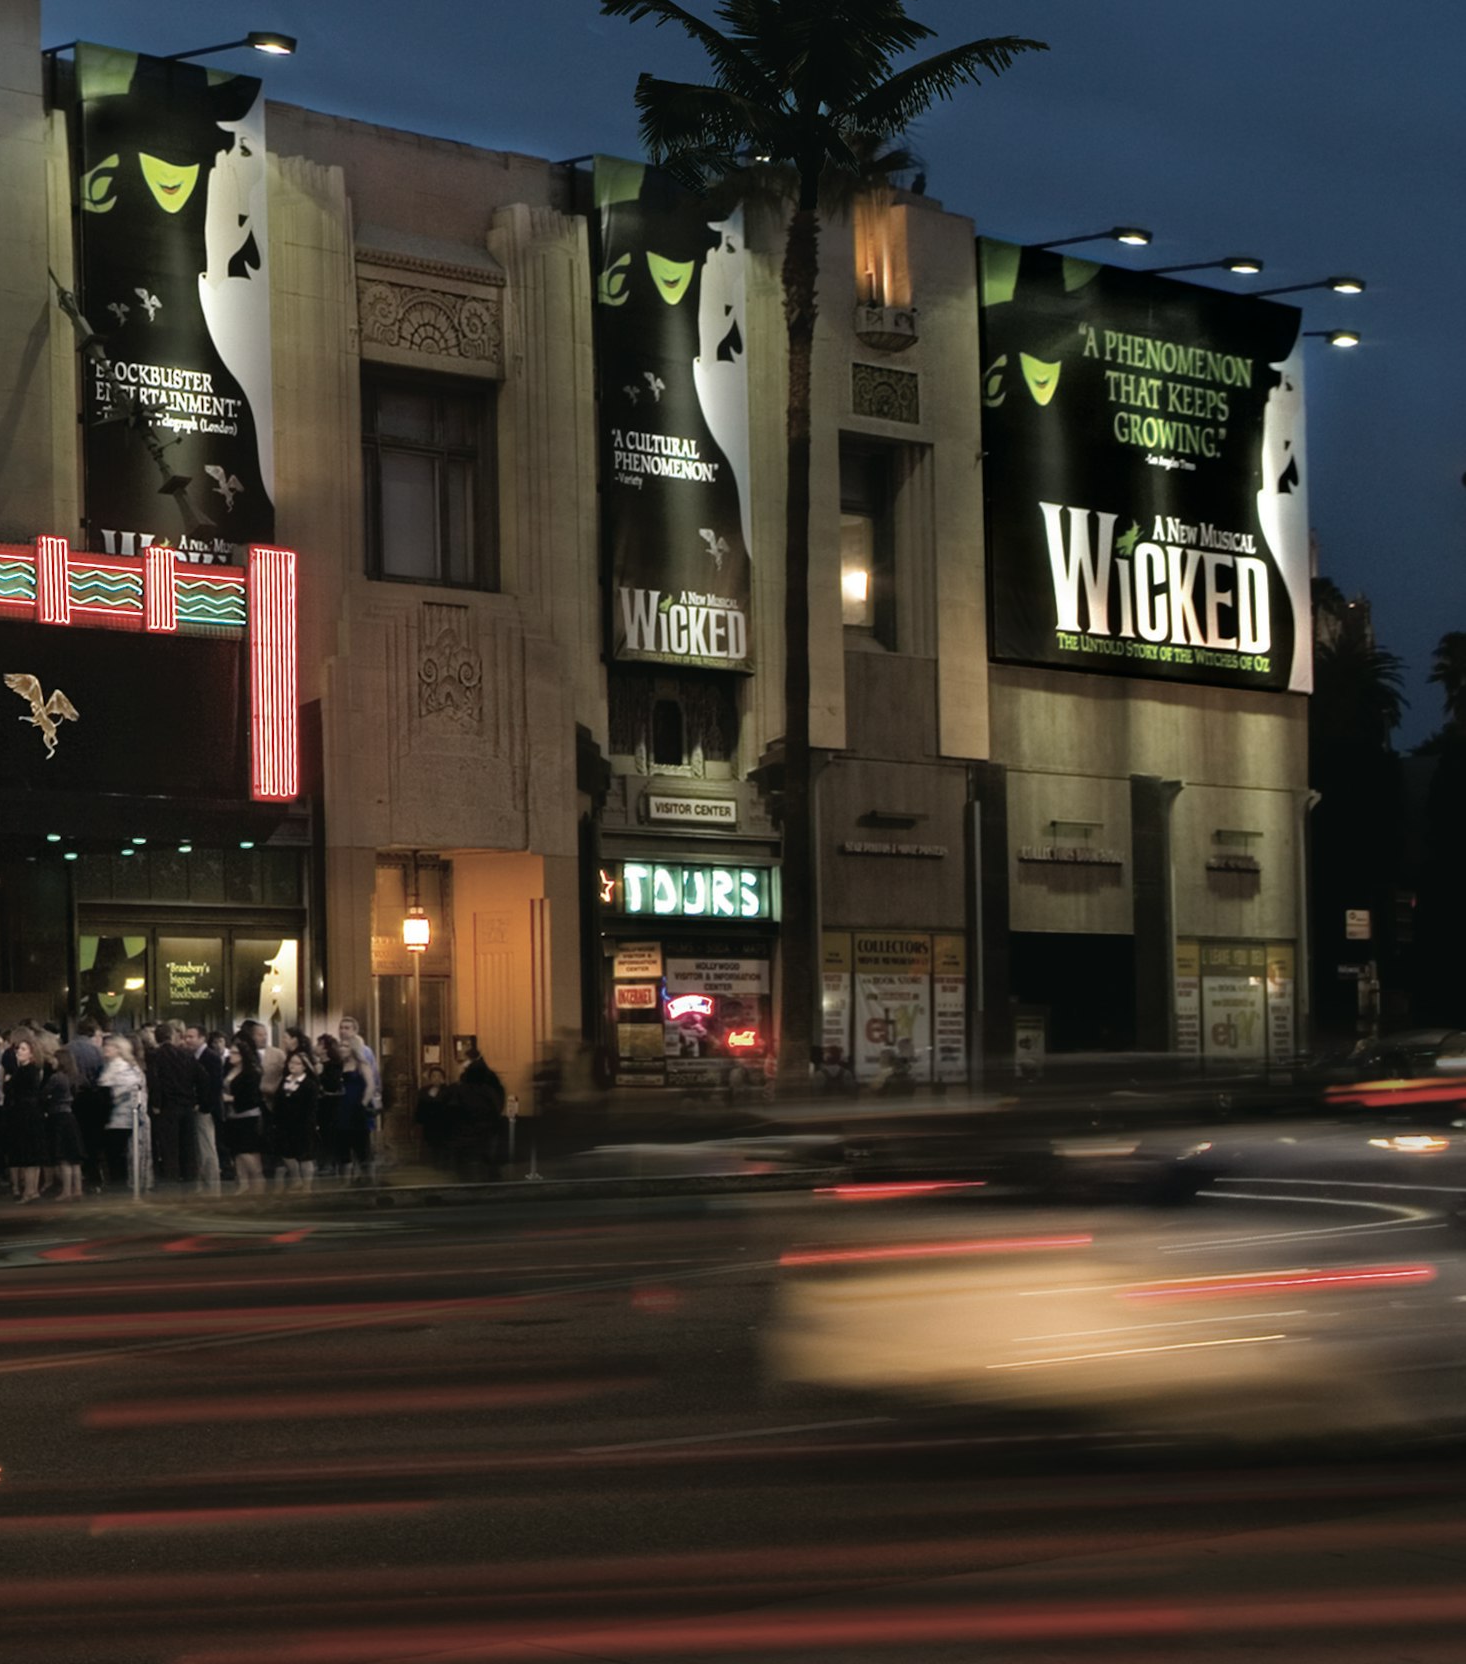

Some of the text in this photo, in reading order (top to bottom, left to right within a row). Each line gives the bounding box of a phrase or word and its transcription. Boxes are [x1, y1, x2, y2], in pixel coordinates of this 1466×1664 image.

[1103, 329, 1254, 389] PHENOMENON
[1104, 370, 1230, 422] THAT KEEPS
[625, 431, 700, 460] CULTURAL
[1152, 514, 1165, 542] A
[655, 802, 732, 817] VISITOR CENTER
[624, 865, 760, 916] TOURS
[857, 939, 929, 954] COLLECTORS
[674, 972, 703, 981] VISITOR
[713, 972, 761, 981] INFORMATION
[694, 962, 741, 971] HOLLYWOOD
[703, 983, 733, 991] CENTER
